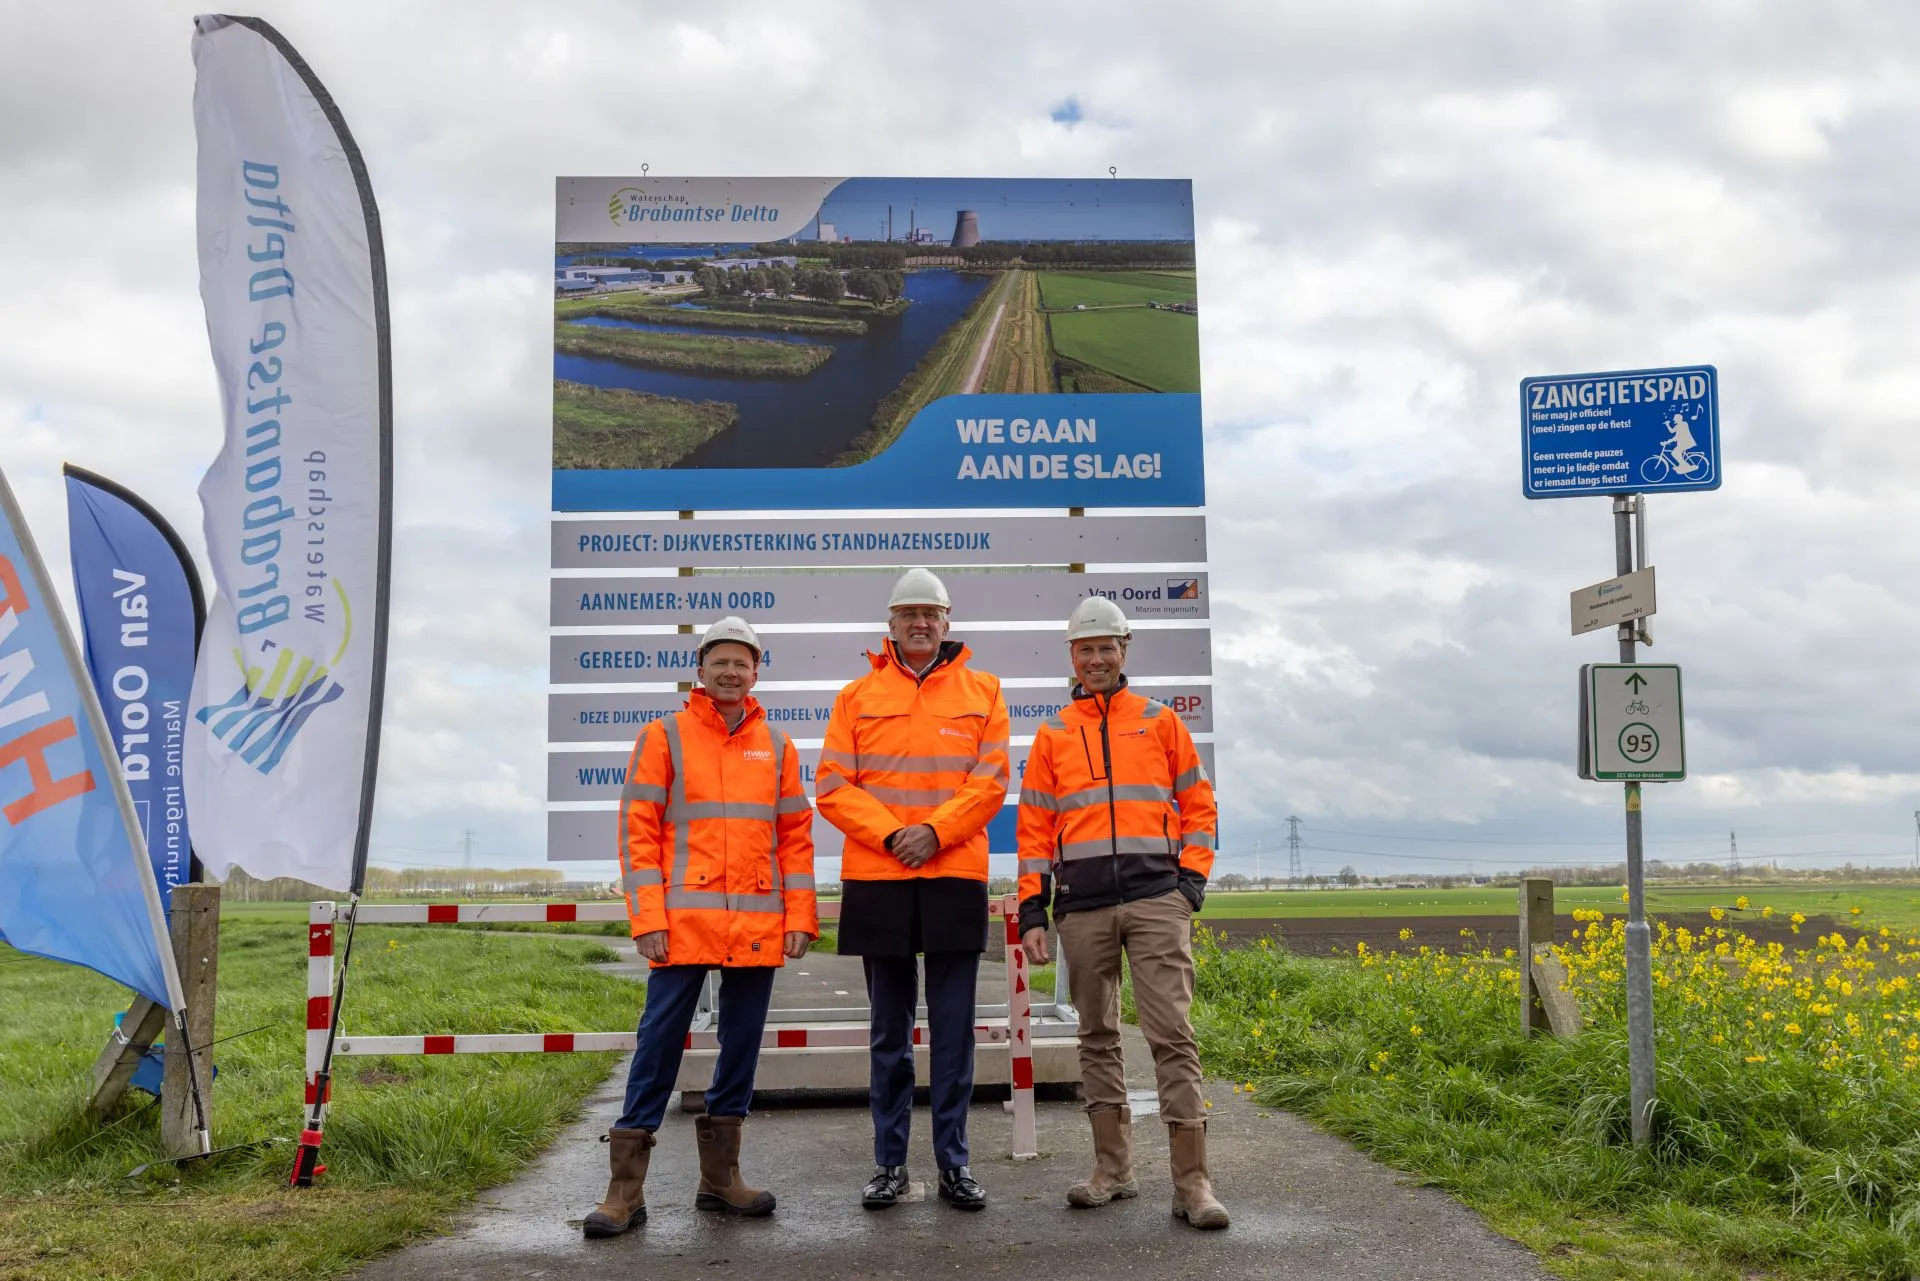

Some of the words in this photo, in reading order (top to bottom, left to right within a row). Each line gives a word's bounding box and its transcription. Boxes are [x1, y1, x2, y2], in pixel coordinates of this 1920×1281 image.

[630, 194, 685, 203] Waterschap
[628, 204, 725, 222] Brabantse
[731, 204, 779, 222] Delta
[1531, 375, 1706, 410] ZANGFIETSPAD
[1532, 412, 1549, 421] Hier
[1550, 412, 1568, 421] mag
[1569, 410, 1578, 420] je
[1579, 407, 1612, 418] officieel
[956, 418, 1005, 444] WE
[1009, 418, 1097, 444] GAAN
[1532, 423, 1556, 435] (mee)
[1557, 423, 1585, 433] zingen
[1586, 423, 1597, 432] op
[1598, 421, 1609, 430] de
[1610, 419, 1632, 429] fiets!
[1533, 452, 1555, 461] Geen
[1556, 449, 1593, 460] vreemde
[1594, 449, 1624, 460] pauzes
[956, 454, 1024, 480] AAN
[1029, 454, 1069, 480] DE
[1073, 452, 1162, 480] SLAG!
[1534, 466, 1556, 474] meer
[1557, 464, 1566, 473] in
[1566, 464, 1575, 474] je
[1576, 462, 1600, 473] liedje
[1601, 461, 1630, 470] omdat
[1534, 479, 1543, 488] er
[1544, 476, 1576, 487] iemand
[1577, 476, 1600, 486] langs
[1602, 474, 1628, 484] fietst!
[579, 534, 658, 552] PROJECT:
[663, 533, 817, 552] DIJKVERSTERKING
[822, 532, 990, 551] STANDHAZENSEDIJK
[579, 592, 682, 611] AANNEMER:
[687, 591, 722, 609] VAN
[727, 591, 775, 609] OORD
[1089, 587, 1117, 600] Van
[1122, 587, 1161, 600] Oord
[1163, 605, 1199, 614] ingenuity
[579, 651, 652, 669] GEREED:
[657, 650, 699, 668] NAJA
[580, 711, 609, 725] DEZE
[767, 708, 812, 721] ERDEEL
[814, 707, 834, 721] VA
[1626, 734, 1652, 753] 95
